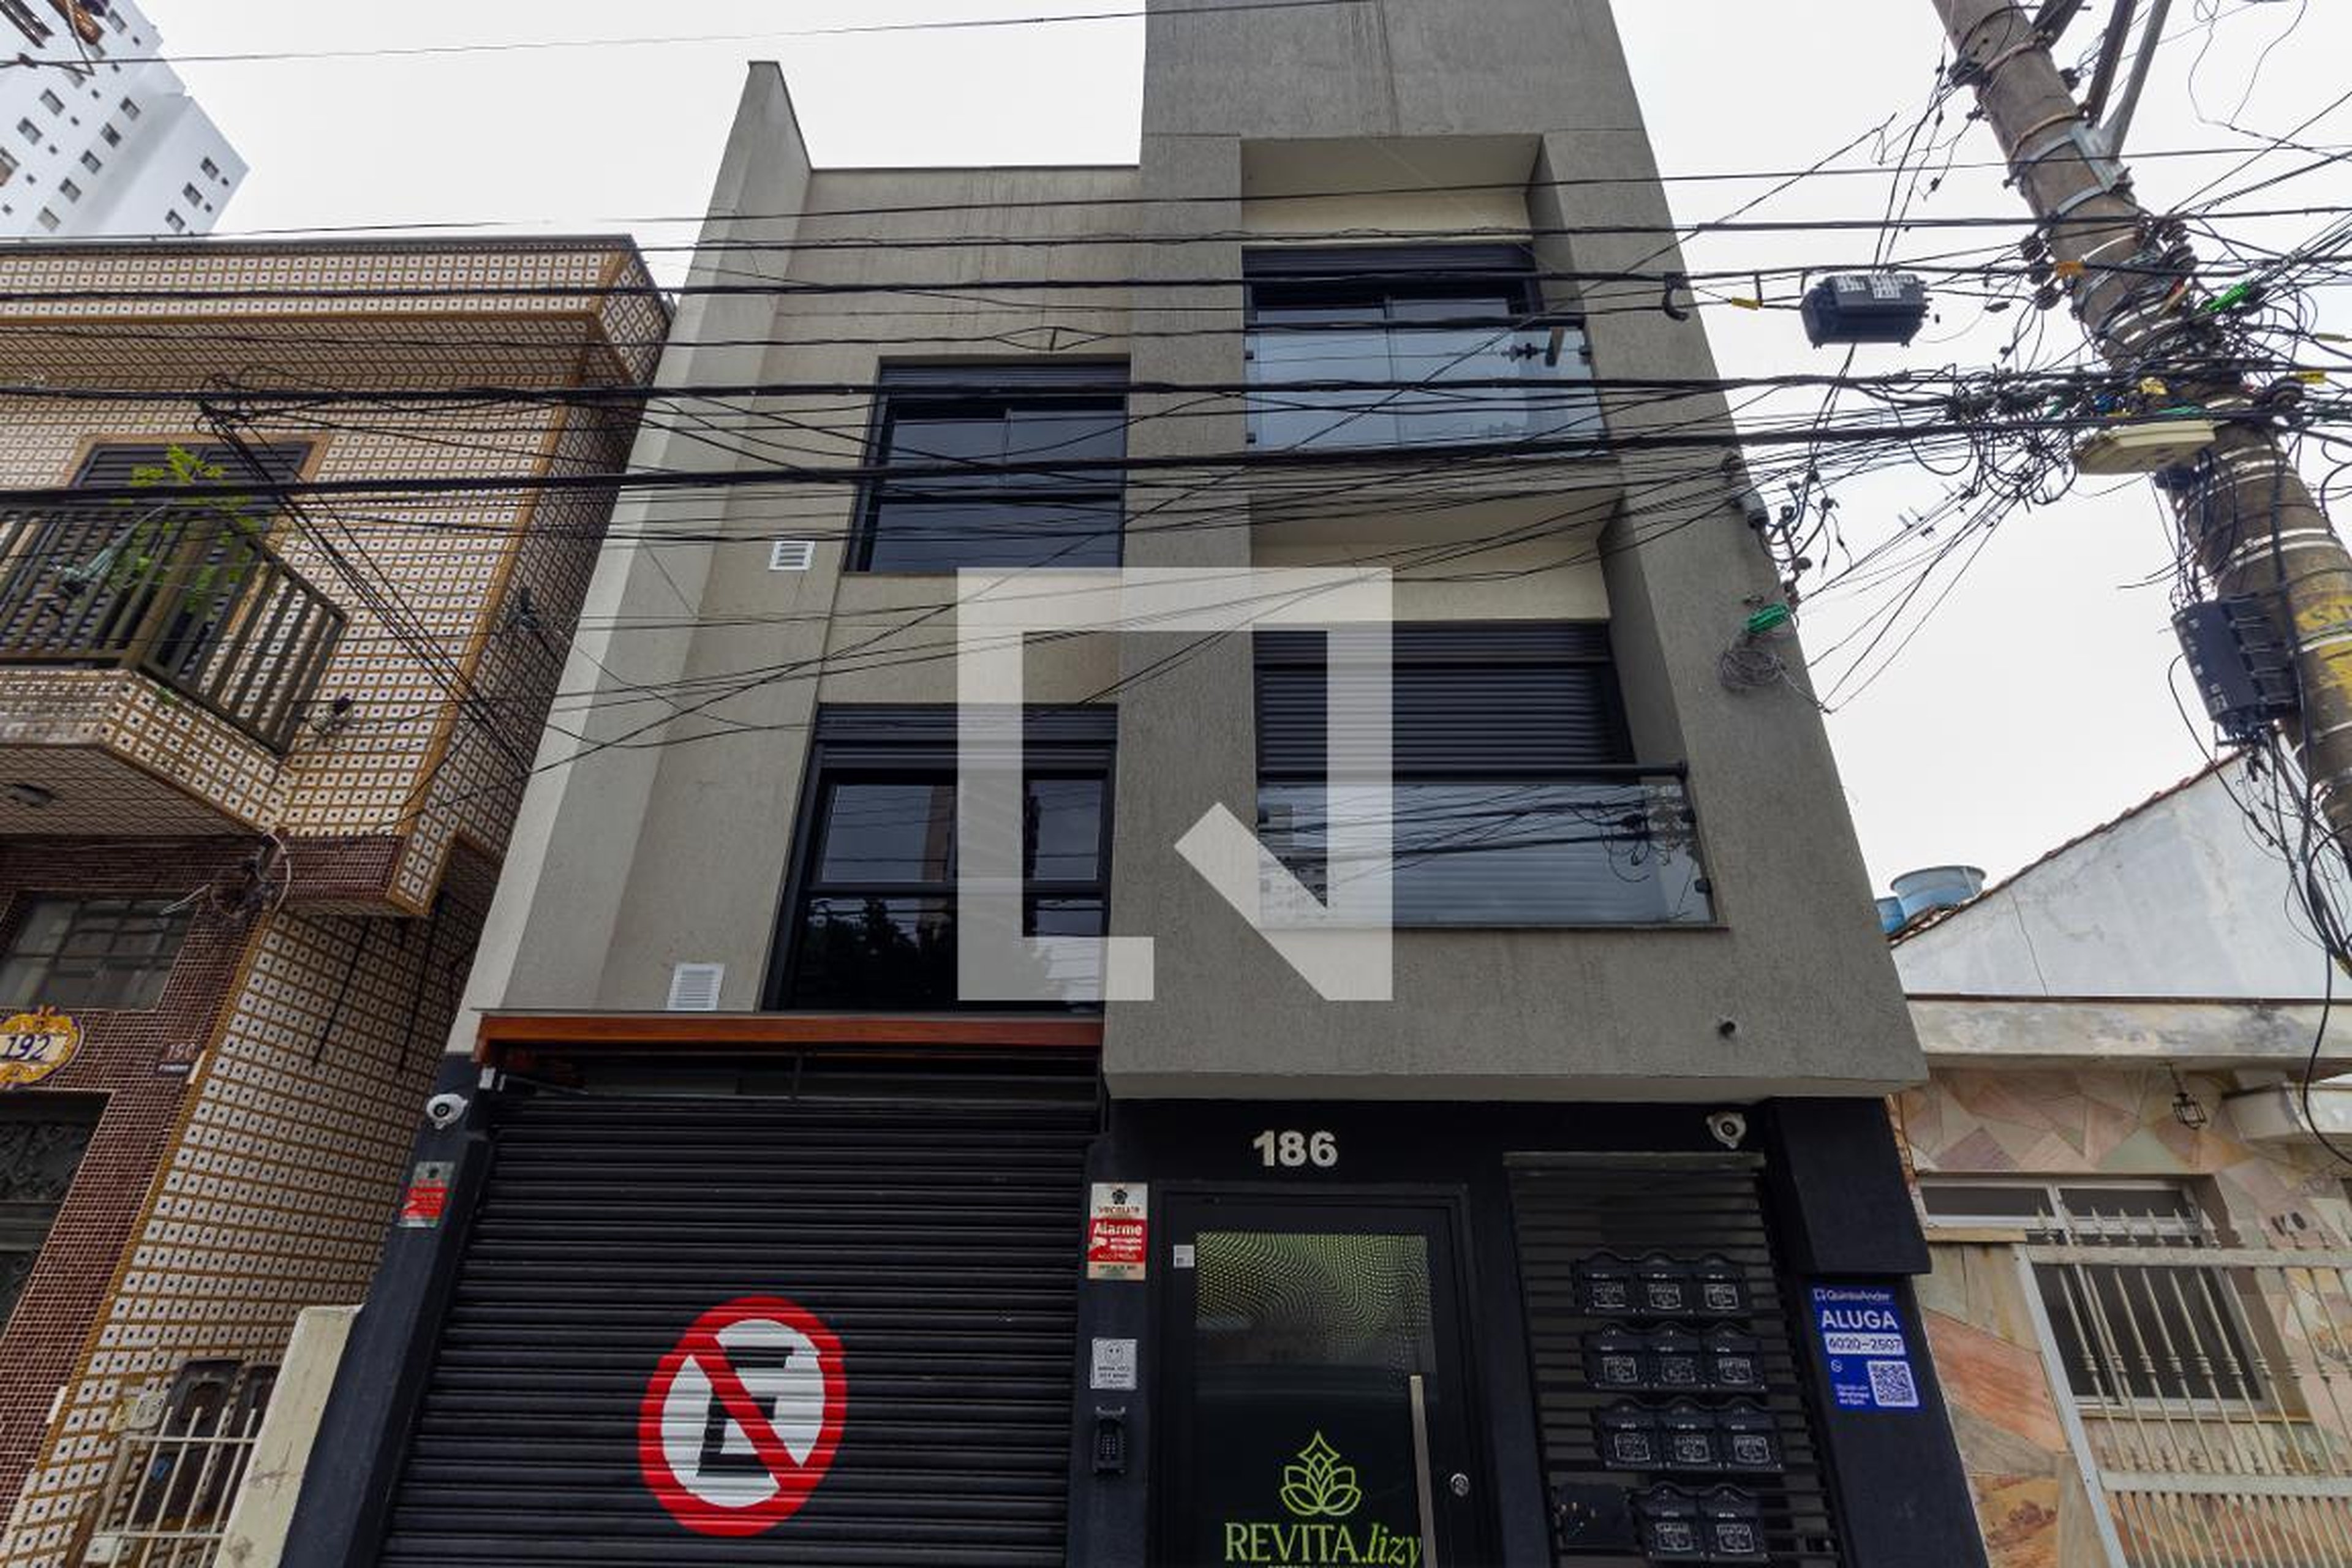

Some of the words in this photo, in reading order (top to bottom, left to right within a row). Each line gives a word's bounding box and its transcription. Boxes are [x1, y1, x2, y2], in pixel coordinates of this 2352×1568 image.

[6, 1034, 50, 1060] 192
[1253, 1131, 1338, 1166] 186
[1095, 1223, 1143, 1235] Alarme
[1822, 1310, 1898, 1329] ALUGA
[1225, 1522, 1422, 1568] REVITA.lizy
